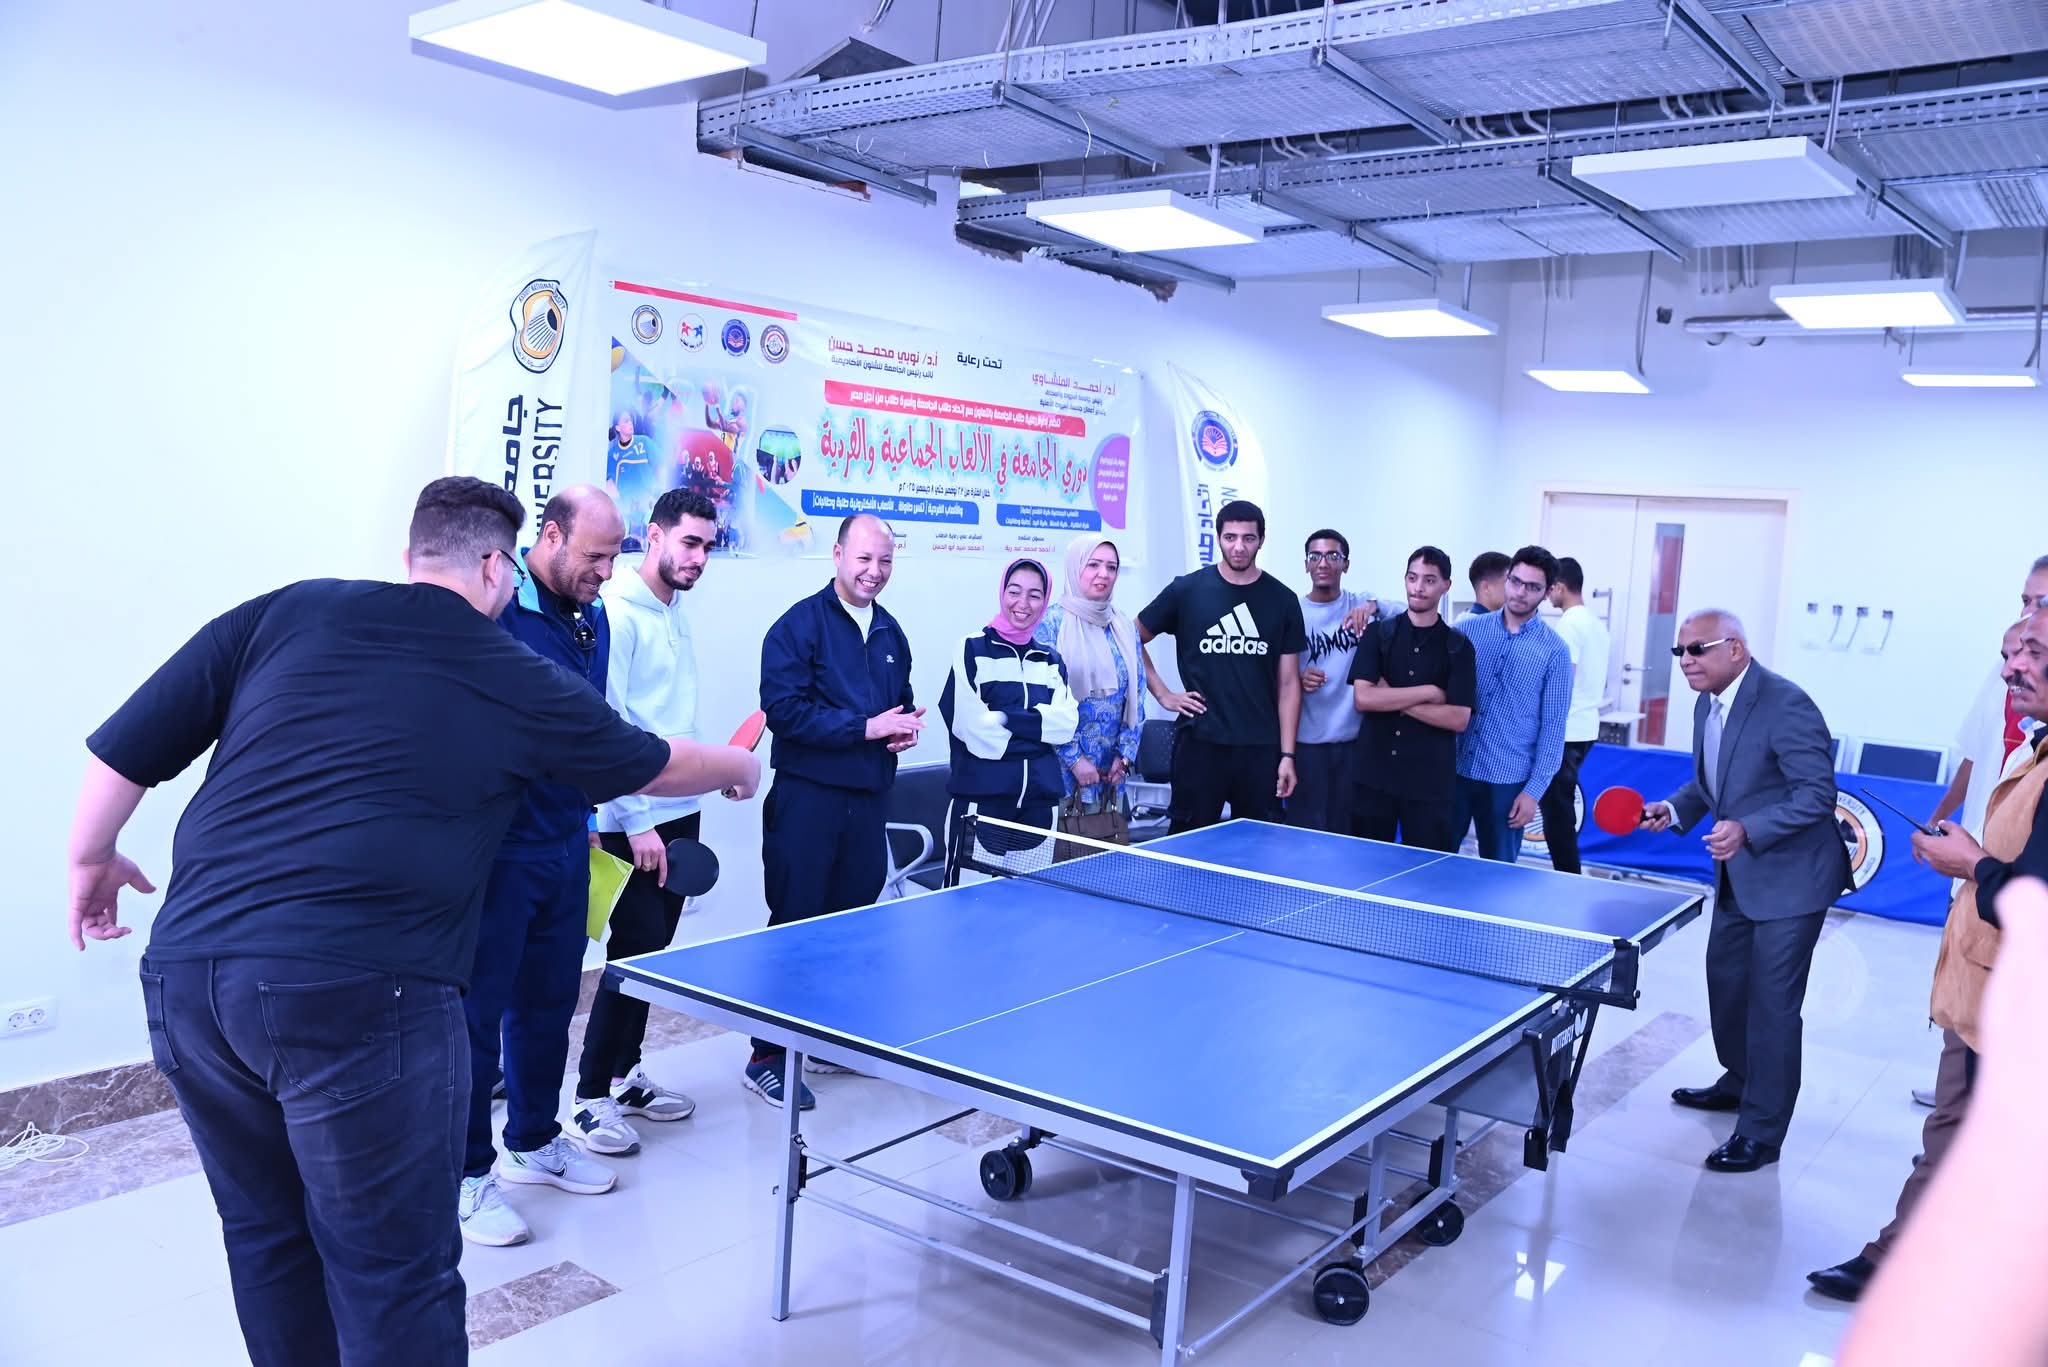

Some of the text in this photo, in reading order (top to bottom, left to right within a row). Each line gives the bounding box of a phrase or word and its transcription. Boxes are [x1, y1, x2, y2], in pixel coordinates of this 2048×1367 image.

[828, 335, 854, 353] حسن
[857, 342, 894, 359] محمد
[898, 350, 920, 367] نوبي
[957, 352, 1003, 370] تحت رعاية
[1032, 371, 1071, 388] المنشاوي
[821, 417, 1088, 493] دوري الجامعة في الألعاب الجماعية والفردية
[1199, 634, 1269, 655] adidas
